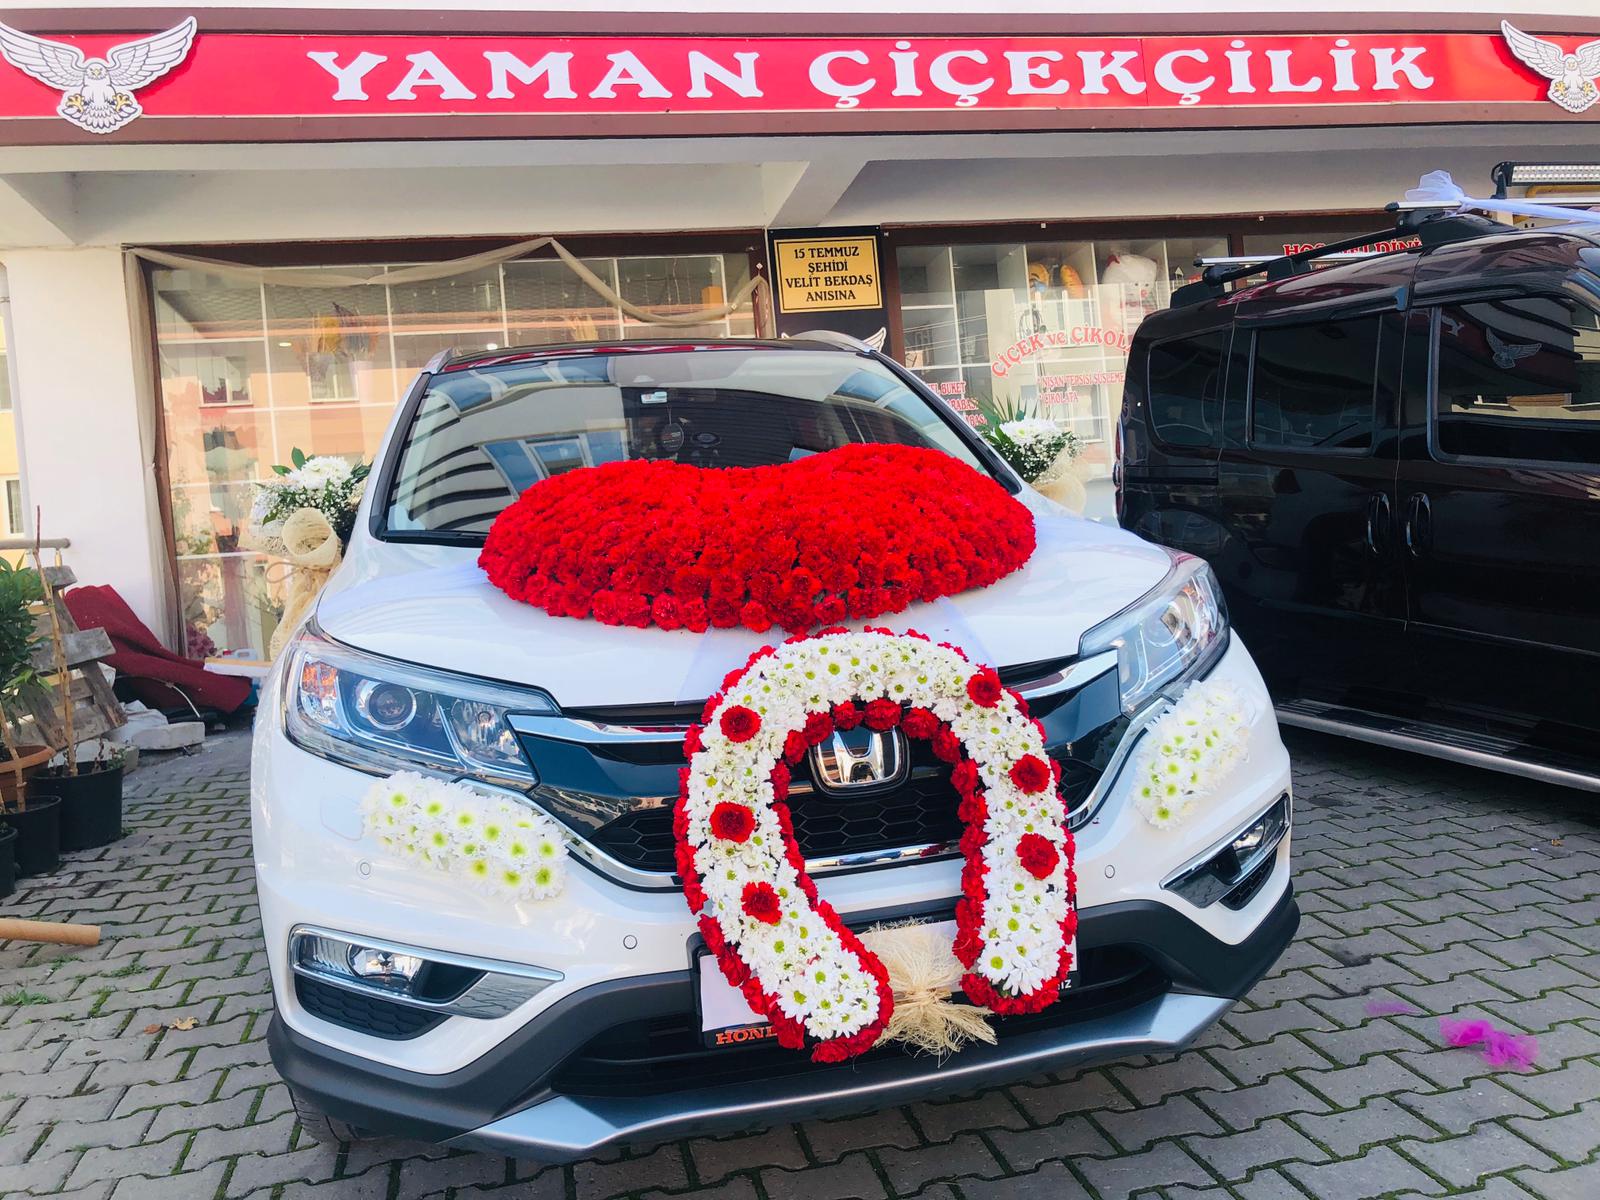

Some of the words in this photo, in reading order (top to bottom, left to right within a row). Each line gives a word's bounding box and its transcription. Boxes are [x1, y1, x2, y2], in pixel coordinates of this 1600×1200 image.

[307, 50, 764, 101] YAMAN
[808, 39, 1435, 109] ÇİÇEKÇİLİK
[794, 248, 805, 259] 15
[808, 246, 860, 258] TEMMUZ
[808, 259, 848, 275] ŞEHİDİ
[785, 275, 821, 288] VELİT
[824, 274, 873, 287] BEKDAŞ
[806, 290, 856, 302] ANISINA
[991, 332, 1044, 378] ÇİÇEK
[1046, 330, 1066, 346] ve
[941, 382, 966, 395] BUKET
